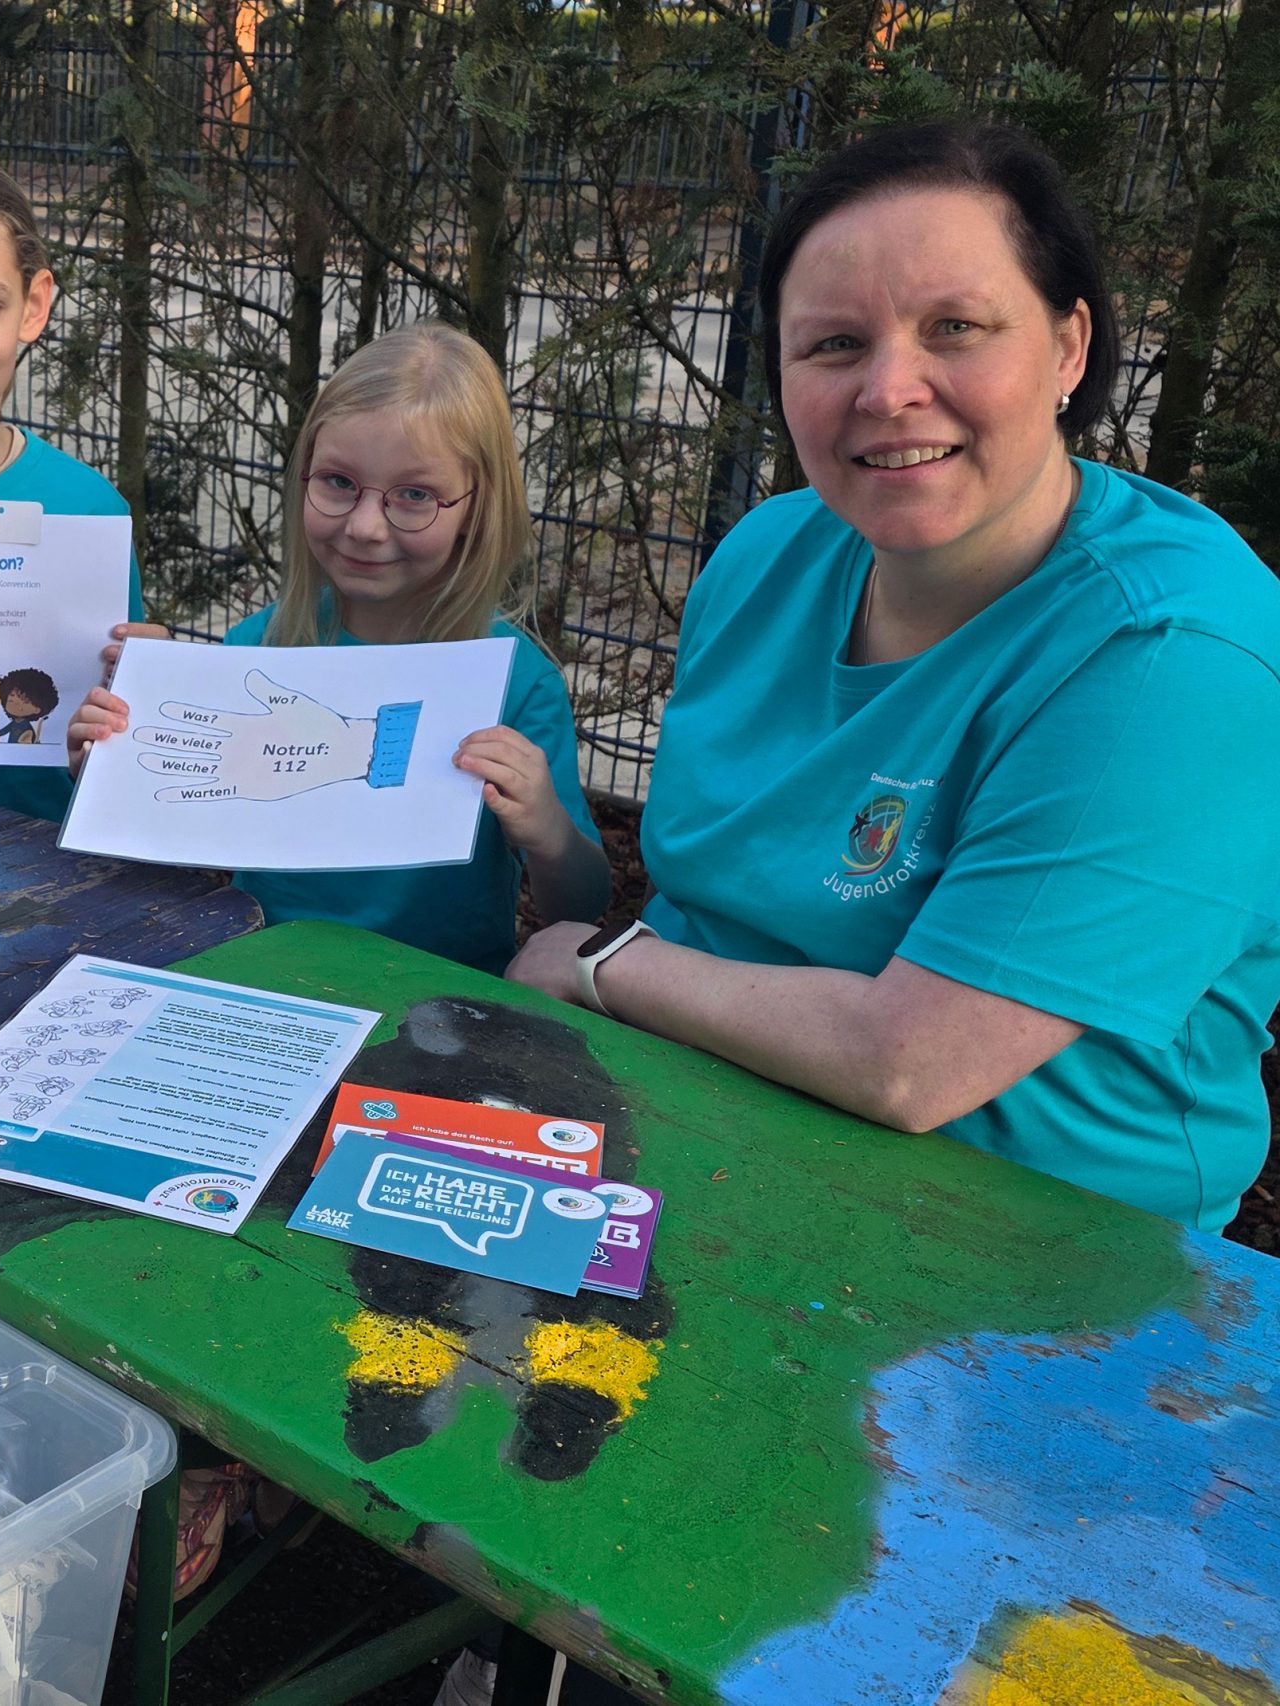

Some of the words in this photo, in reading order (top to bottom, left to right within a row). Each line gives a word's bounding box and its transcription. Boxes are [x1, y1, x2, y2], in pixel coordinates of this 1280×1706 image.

[0, 609, 27, 617] schützt
[268, 695, 298, 705] Wo?
[182, 710, 218, 724] Was?
[154, 732, 178, 745] Wie
[181, 737, 222, 750] viele?
[262, 742, 330, 756] Notruf:
[161, 759, 218, 774] Welche?
[273, 760, 308, 773] 112
[871, 772, 910, 790] Deutsches
[823, 802, 937, 901] Jugendrotkreuz
[412, 1124, 426, 1132] Ich
[427, 1127, 449, 1136] habe
[451, 1130, 468, 1139] das
[469, 1133, 495, 1144] Recht
[497, 1138, 515, 1147] auf:
[159, 1178, 251, 1198] Jugendrotkreuz
[386, 1169, 418, 1184] ICH
[424, 1172, 507, 1200] HABE
[381, 1184, 411, 1197] DAS
[414, 1184, 520, 1217] RECHT
[305, 1210, 352, 1229] STARK
[310, 1204, 354, 1221] LAUT
[379, 1194, 412, 1206] AUF
[415, 1200, 511, 1227] BETEILIGUNG
